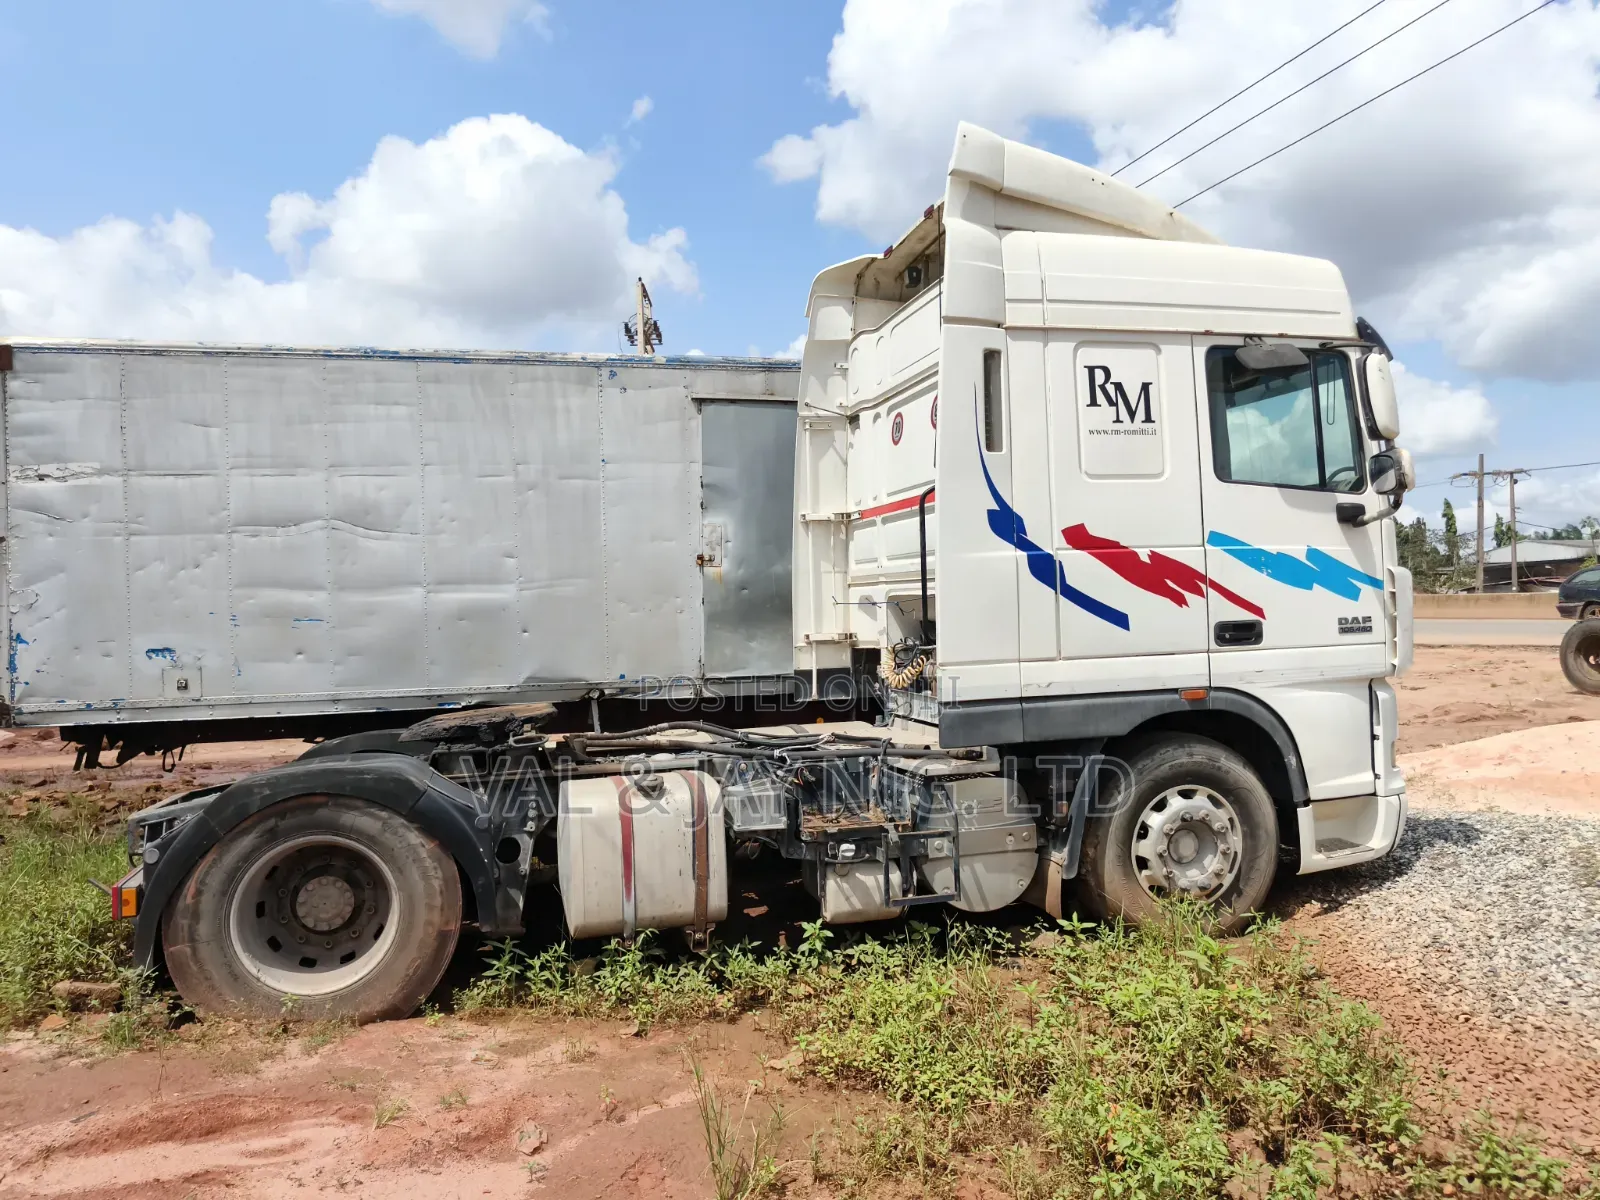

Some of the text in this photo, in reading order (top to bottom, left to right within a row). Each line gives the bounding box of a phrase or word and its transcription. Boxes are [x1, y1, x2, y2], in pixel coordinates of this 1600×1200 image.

[1083, 365, 1156, 424] RM
[1088, 427, 1157, 436] www.rm-romitti.it
[1337, 616, 1372, 625] DAF
